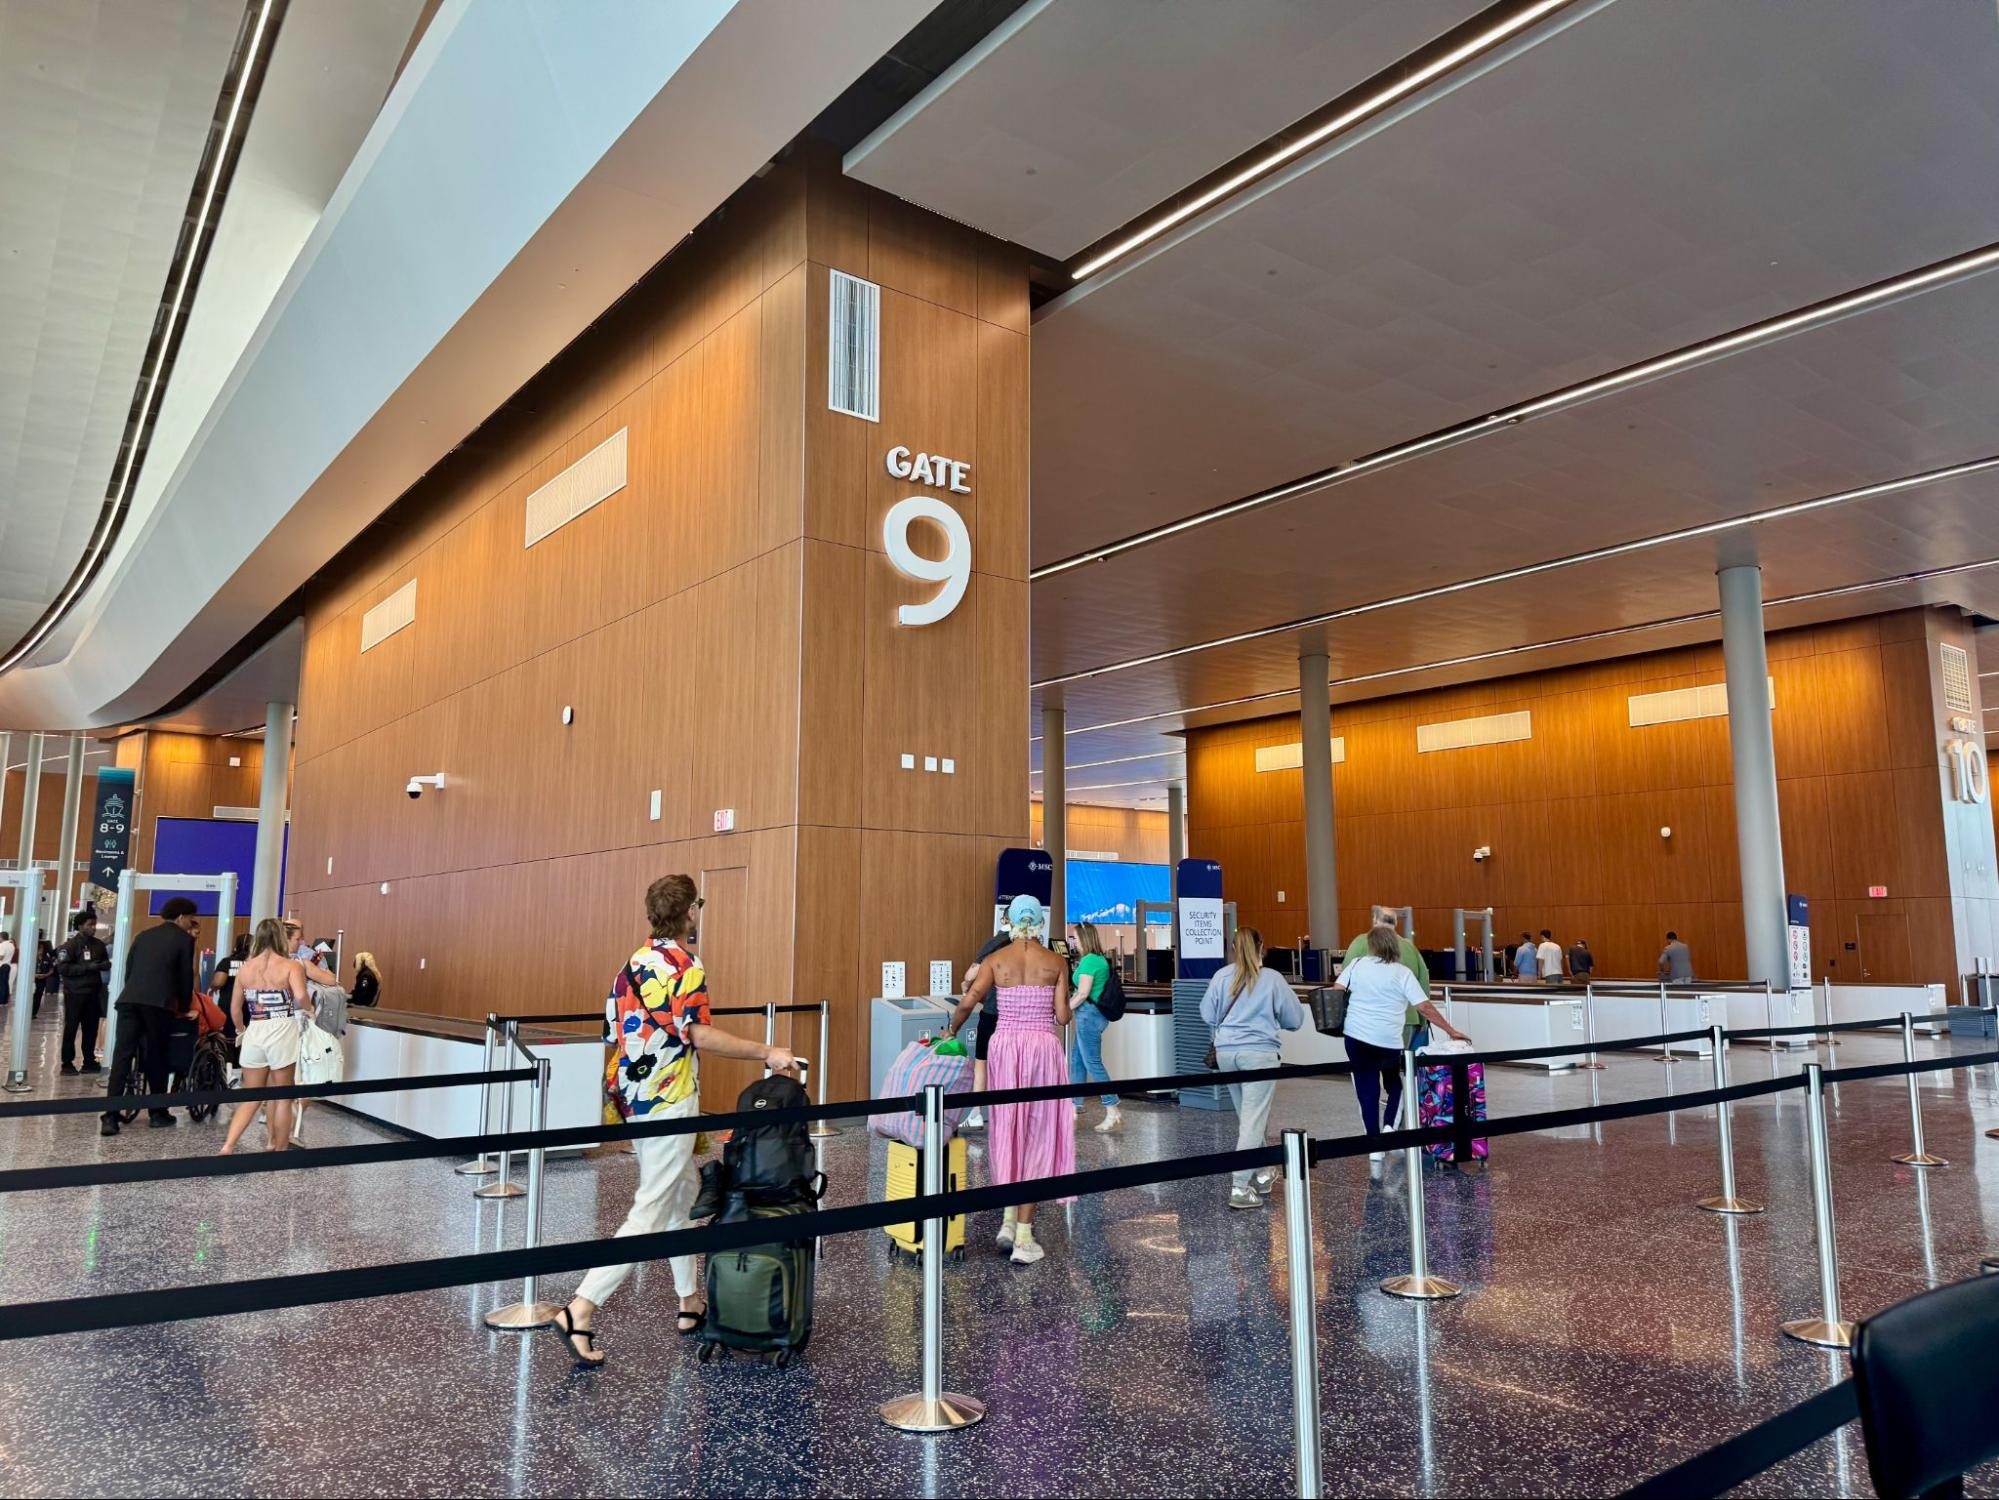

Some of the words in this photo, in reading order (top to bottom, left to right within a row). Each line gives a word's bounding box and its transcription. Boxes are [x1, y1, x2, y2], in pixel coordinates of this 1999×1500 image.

[886, 445, 972, 494] GATE
[883, 496, 972, 626] 9
[1945, 738, 1987, 804] 10
[99, 823, 125, 834] 8-9
[1037, 863, 1053, 871] MSC
[1189, 911, 1217, 919] SECURITY
[1194, 920, 1213, 928] ITEMS
[1185, 928, 1222, 937] COLLECTION
[1194, 937, 1213, 945] POINT
